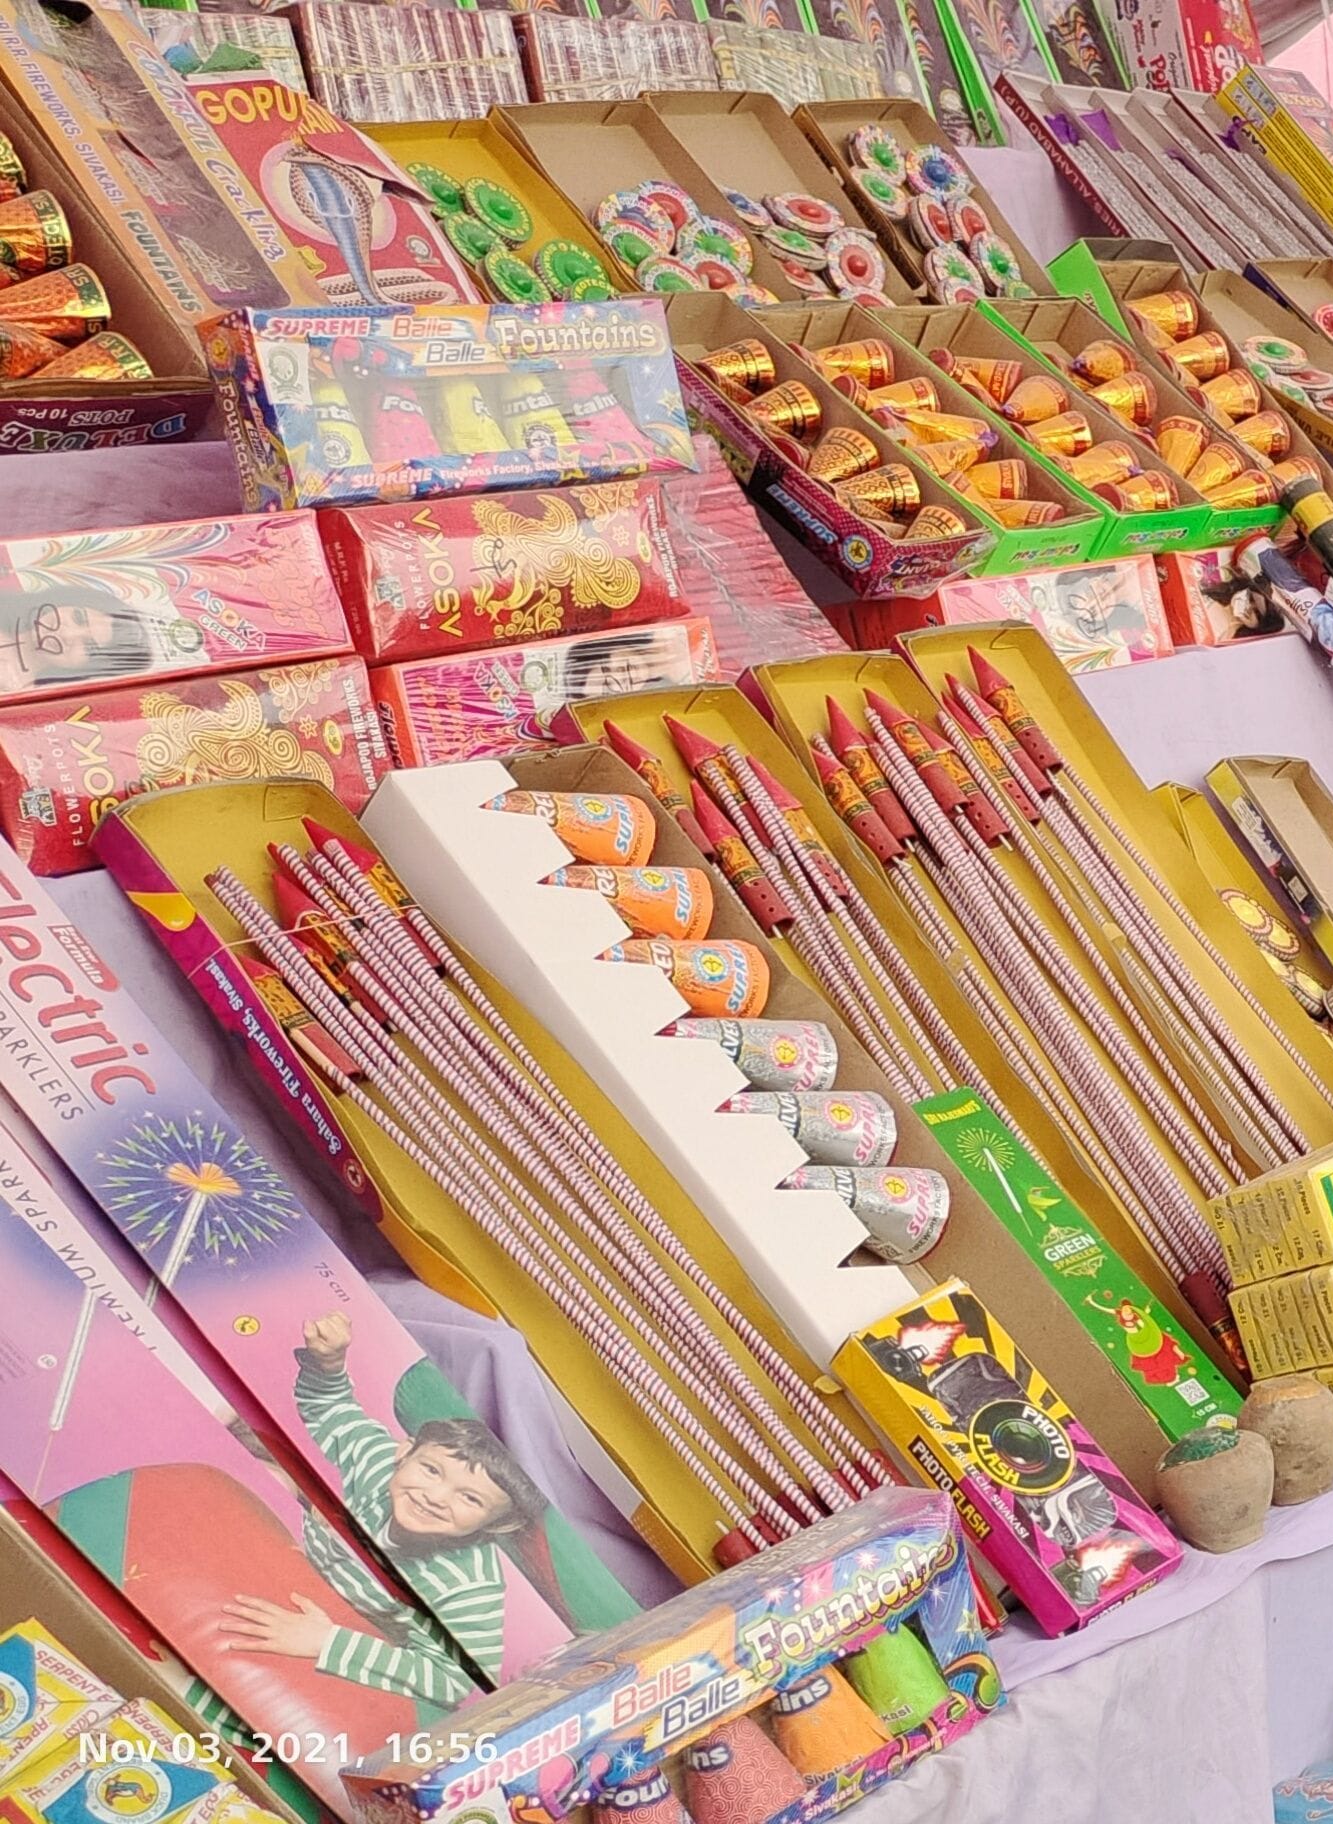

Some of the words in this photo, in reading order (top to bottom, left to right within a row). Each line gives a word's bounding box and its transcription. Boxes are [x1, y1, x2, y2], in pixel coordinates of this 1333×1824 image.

[999, 84, 1030, 124] (U.P.)
[21, 60, 83, 140] FIREWORKS,
[74, 143, 126, 208] SIVAKASI.
[120, 209, 202, 315] FOUNTAINS
[1029, 122, 1093, 199] ALLAHABAD
[204, 157, 287, 263] Crackling
[266, 317, 369, 338] SUPREME
[391, 316, 453, 339] Balle
[425, 341, 487, 364] Balle
[497, 316, 658, 355] Fountains
[0, 413, 187, 454] DELUXE
[49, 409, 68, 420] 10
[67, 408, 136, 427] POTS
[351, 467, 433, 488] SUPREME
[491, 462, 533, 477] Factory,
[766, 483, 839, 545] SUPREME
[411, 506, 464, 638] ASOKA
[191, 588, 268, 651] ASOKA
[198, 613, 250, 651] GREEN
[341, 677, 364, 737] FIREWORKS.
[472, 661, 519, 720] ASOKA
[364, 708, 390, 760] SIVAKASI
[64, 704, 121, 828] SOKA
[51, 925, 105, 986] Formula
[203, 957, 244, 1012] Sivakasi.
[241, 1006, 303, 1098] Fireworks,
[301, 1093, 343, 1156] Sahara
[1042, 1232, 1098, 1264] GREEN
[312, 1260, 335, 1280] 75
[327, 1279, 352, 1304] cm
[973, 1432, 1021, 1486] FLASH
[1020, 1405, 1072, 1460] PHOTO
[911, 1440, 955, 1492] PHOTO
[950, 1490, 992, 1539] FLASH
[990, 1492, 1031, 1540] SIVAKASI
[35, 1649, 103, 1698] SERPENT
[611, 1659, 693, 1728] Balle
[659, 1676, 743, 1740] Balle
[445, 1715, 582, 1810] SUPREME
